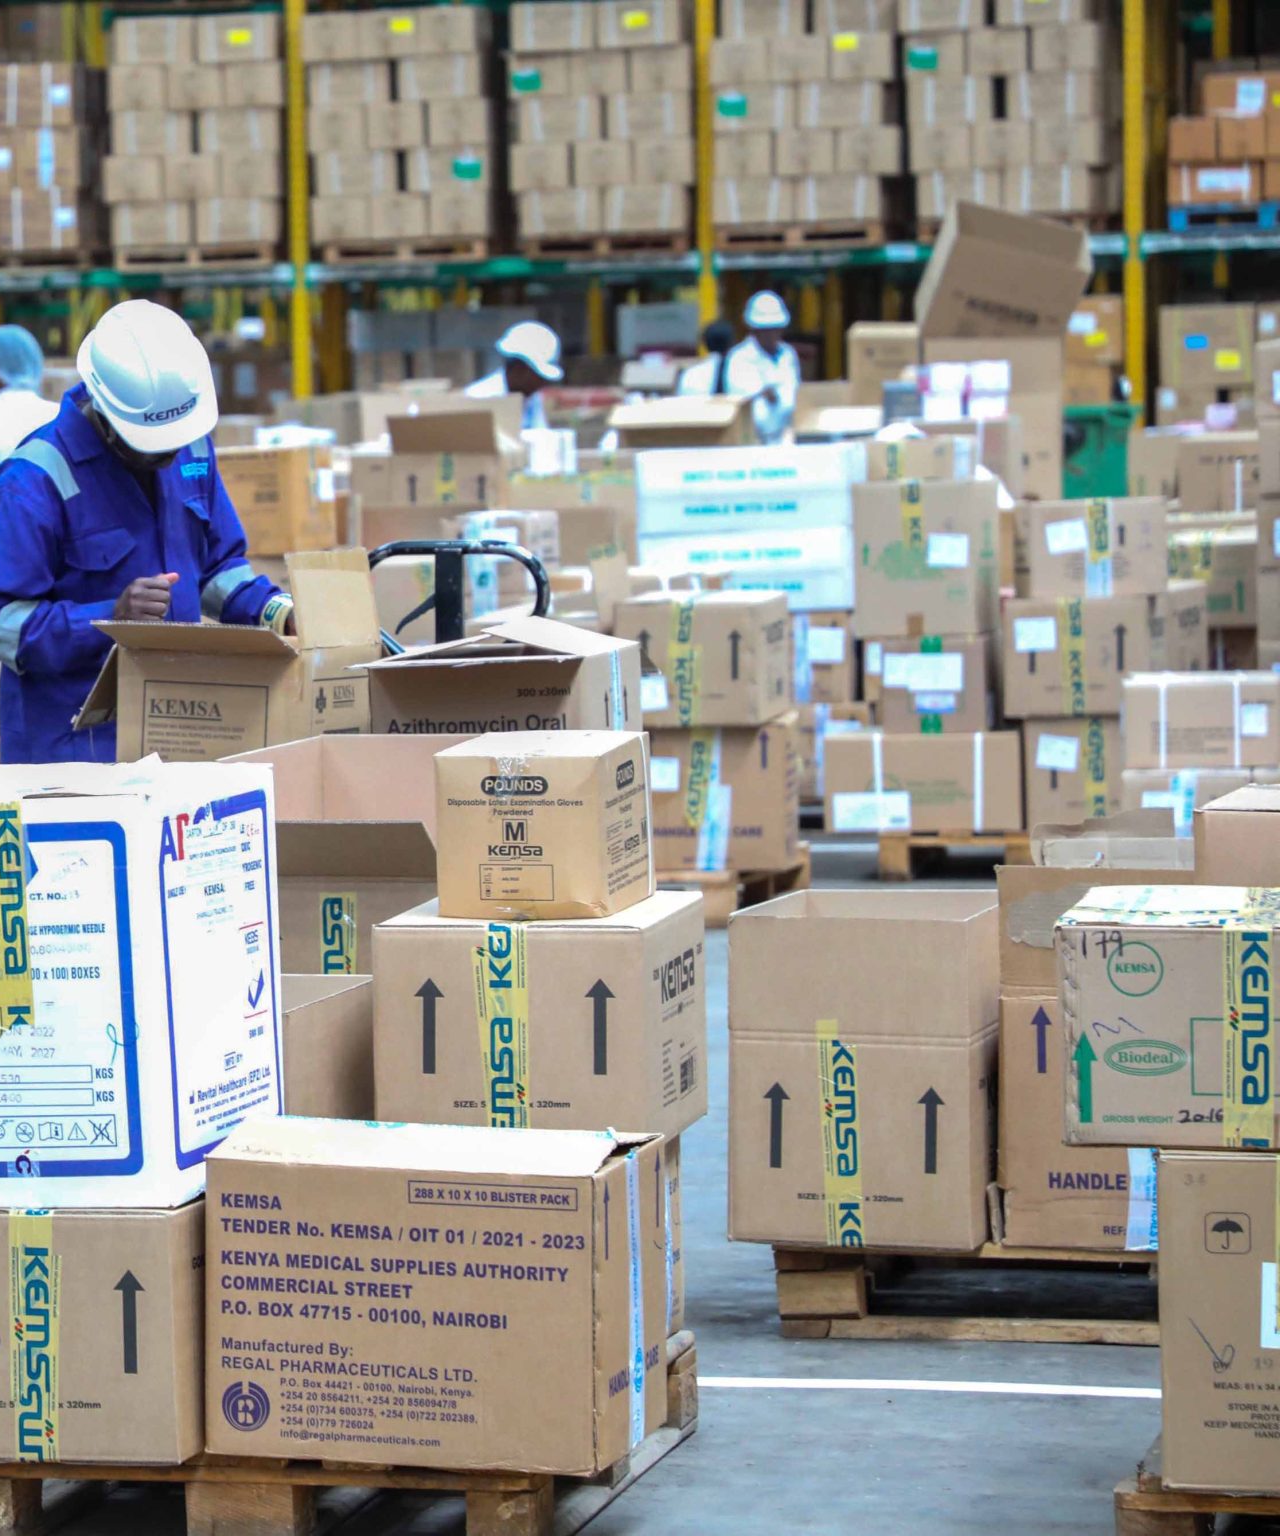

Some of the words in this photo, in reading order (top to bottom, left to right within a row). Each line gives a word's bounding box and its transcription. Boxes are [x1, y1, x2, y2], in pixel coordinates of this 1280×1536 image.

[151, 698, 222, 718] KEMSA
[388, 715, 518, 734] Azithromycin
[525, 713, 567, 731] Oral
[484, 779, 544, 792] POUNDS
[447, 798, 487, 807] Disposable
[510, 798, 555, 807] Examination
[557, 798, 584, 807] Gloves
[505, 821, 525, 841] M
[39, 923, 81, 937] HYPODERMIC
[82, 922, 106, 934] NEEDLE
[1080, 930, 1124, 959] 179
[71, 966, 101, 980] BOXES
[1115, 962, 1156, 974] KEMSA
[1118, 1051, 1174, 1064] Biodeal
[95, 1067, 114, 1080] KGS
[96, 1090, 115, 1102] KGS
[536, 1100, 570, 1109] 320mm
[1102, 1114, 1135, 1124] GROSS
[1136, 1115, 1174, 1124] WEIGHT
[1048, 1171, 1128, 1191] HANDLE
[221, 1192, 282, 1211] KEMSA
[414, 1187, 434, 1200] 288
[437, 1188, 445, 1200] X
[448, 1189, 461, 1201] 10
[464, 1190, 472, 1201] X
[475, 1190, 488, 1202] 10
[491, 1191, 537, 1205] BLISTER
[541, 1194, 570, 1206] PACK
[221, 1217, 291, 1236] TENDER
[297, 1222, 325, 1238] No.
[331, 1223, 393, 1241] KEMSA
[409, 1227, 440, 1244] OIT
[445, 1229, 465, 1245] 01
[482, 1231, 524, 1248] 2021
[542, 1234, 585, 1251] 2023
[221, 1250, 281, 1268] KENYA
[286, 1253, 365, 1272] MEDICAL
[370, 1257, 458, 1276] SUPPLIES
[463, 1262, 569, 1282] AUTHORITY
[221, 1274, 339, 1296] COMMERCIAL
[344, 1281, 414, 1300] STREET
[221, 1300, 252, 1316] P.O.
[259, 1302, 294, 1317] BOX
[299, 1303, 352, 1321] 47715
[368, 1307, 426, 1328] 00100,
[432, 1311, 508, 1330] NAIROBI
[221, 1337, 324, 1355] Manufactured
[329, 1342, 354, 1358] By:
[221, 1355, 275, 1372] REGAL
[280, 1359, 439, 1381] PHARMACEUTICALS
[444, 1368, 478, 1384] LTD.
[280, 1378, 300, 1388] P.O.
[303, 1378, 321, 1389] Box
[324, 1379, 353, 1391] 44421
[363, 1382, 395, 1394] 00100,
[398, 1384, 438, 1396] Nairobi,
[66, 1400, 102, 1409] 320mm
[1204, 1420, 1228, 1429] KEEP
[280, 1429, 441, 1447] info@regalpharmaceuticals.com
